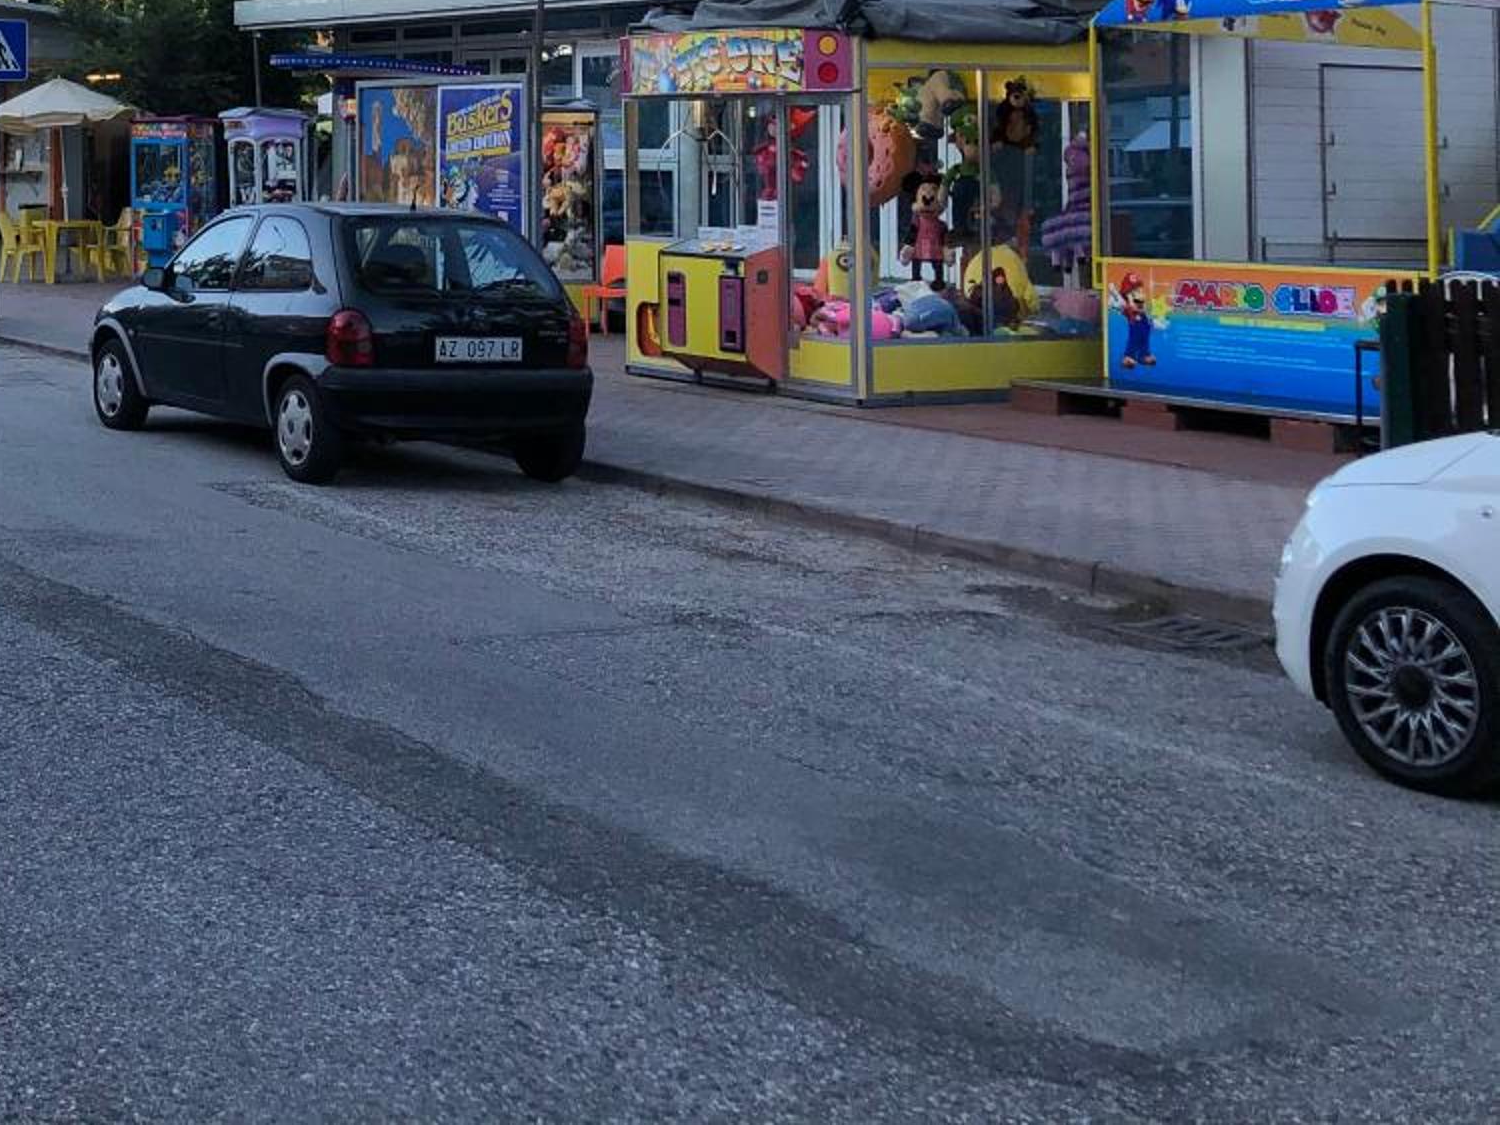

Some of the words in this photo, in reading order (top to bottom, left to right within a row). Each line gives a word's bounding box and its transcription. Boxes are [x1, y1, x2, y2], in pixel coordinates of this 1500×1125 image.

[1174, 279, 1267, 313] MARIO
[439, 340, 458, 358] AZ
[467, 340, 496, 358] 097
